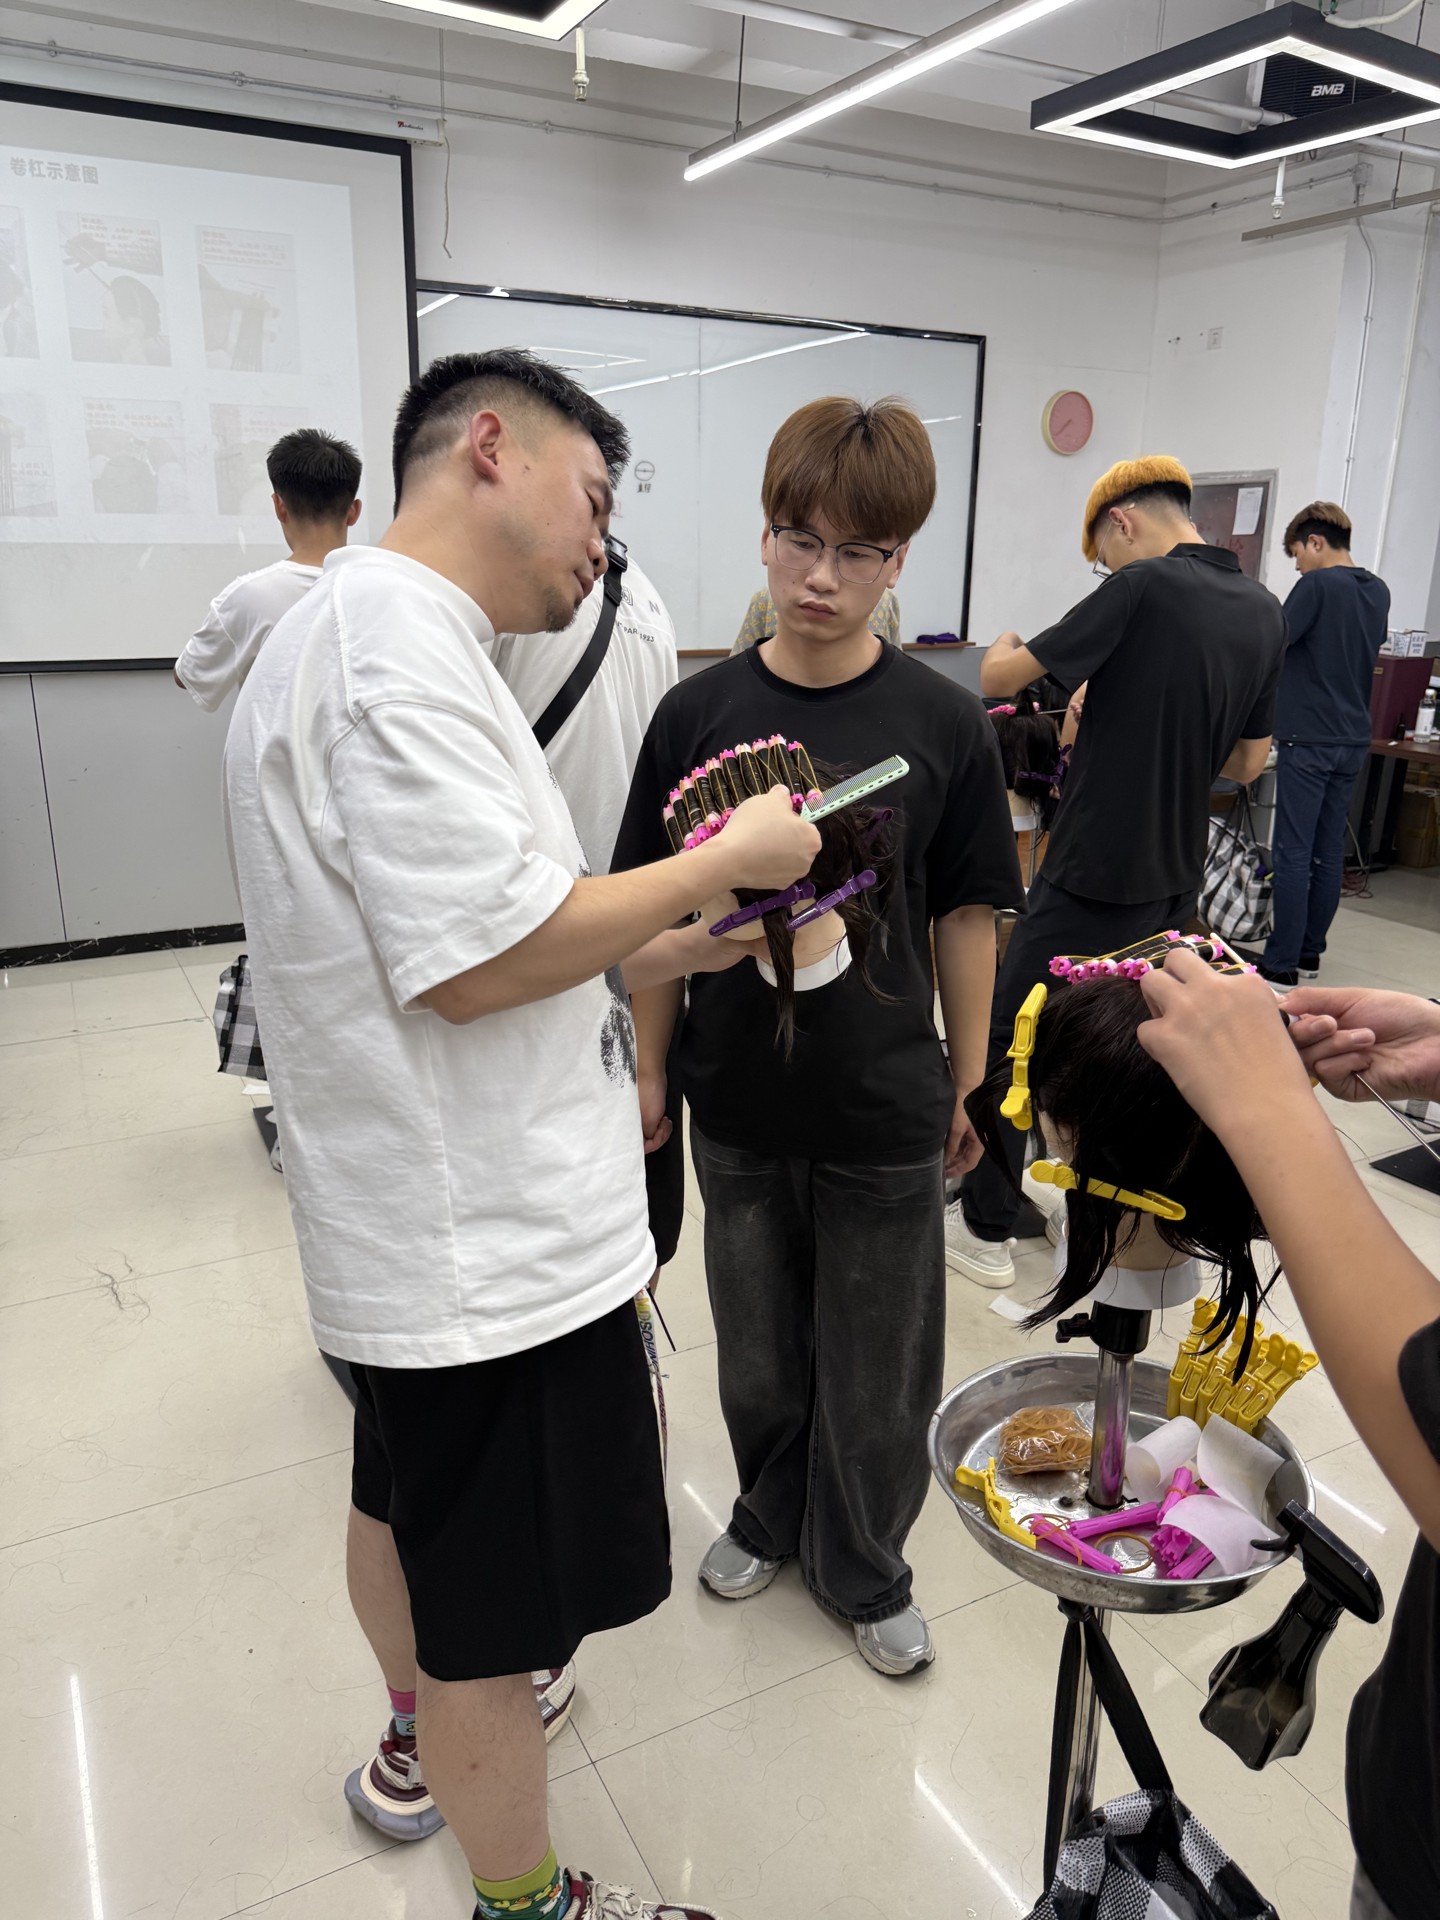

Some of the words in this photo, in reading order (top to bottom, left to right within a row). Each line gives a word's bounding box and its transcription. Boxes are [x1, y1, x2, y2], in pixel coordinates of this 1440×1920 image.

[1311, 83, 1345, 97] BMB
[10, 156, 99, 185] 卷杠示意图
